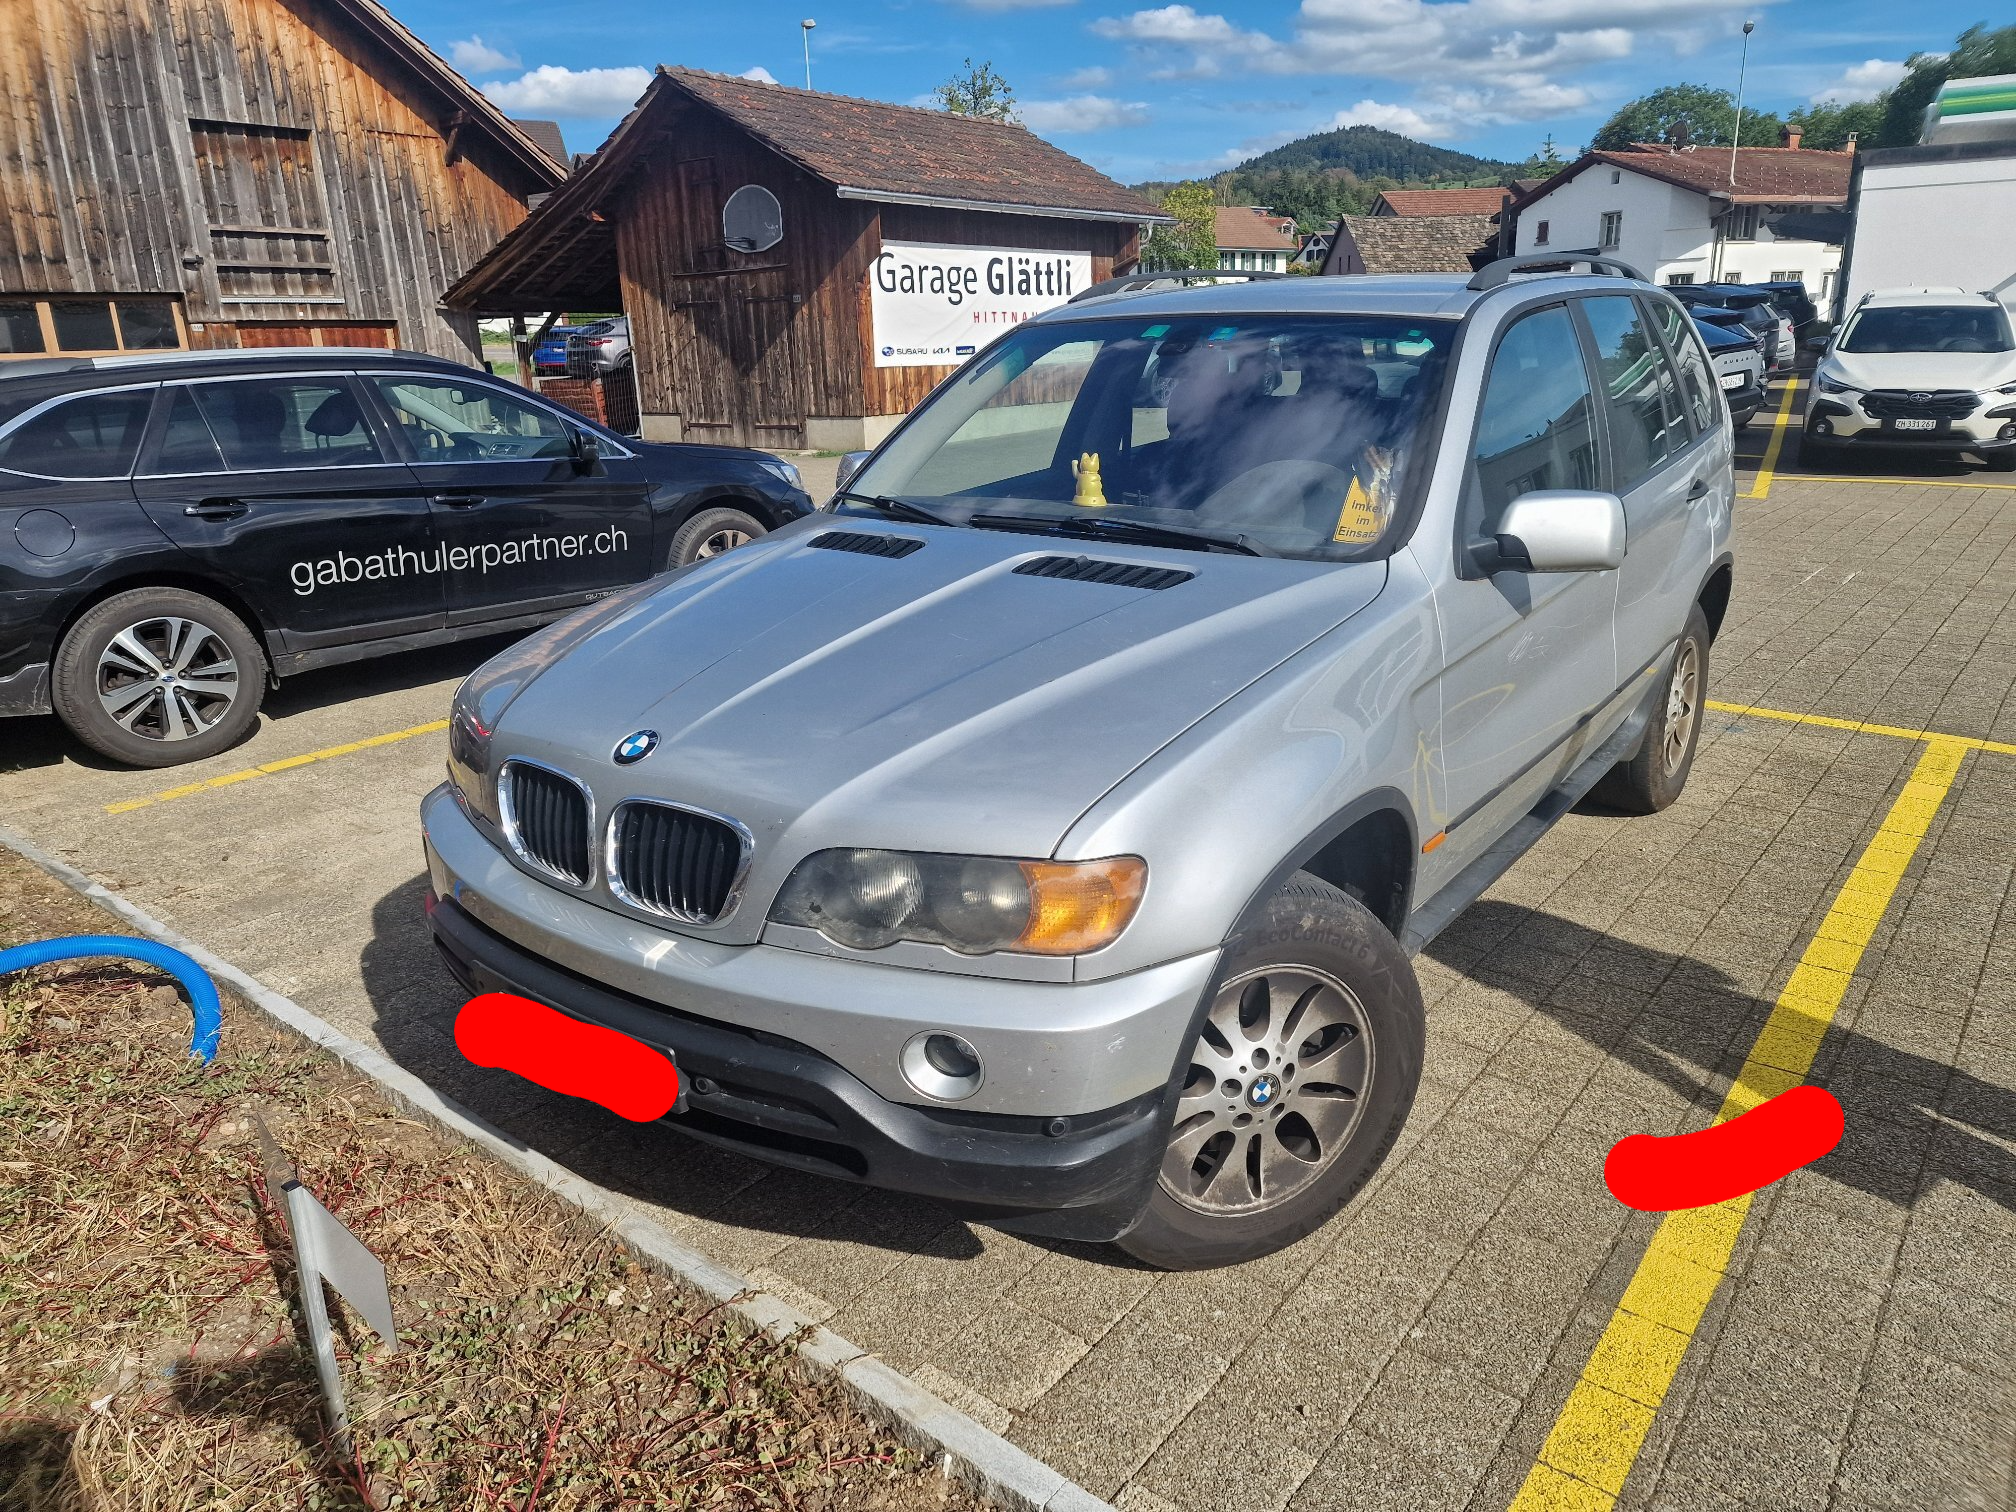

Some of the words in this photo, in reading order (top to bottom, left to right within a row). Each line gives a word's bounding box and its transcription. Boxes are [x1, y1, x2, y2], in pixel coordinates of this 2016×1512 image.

[876, 252, 978, 306] Garage
[986, 256, 1072, 296] Glättli
[1338, 525, 1379, 538] Einsatz
[1355, 514, 1370, 525] im
[290, 524, 628, 596] gabathulerpartner.ch
